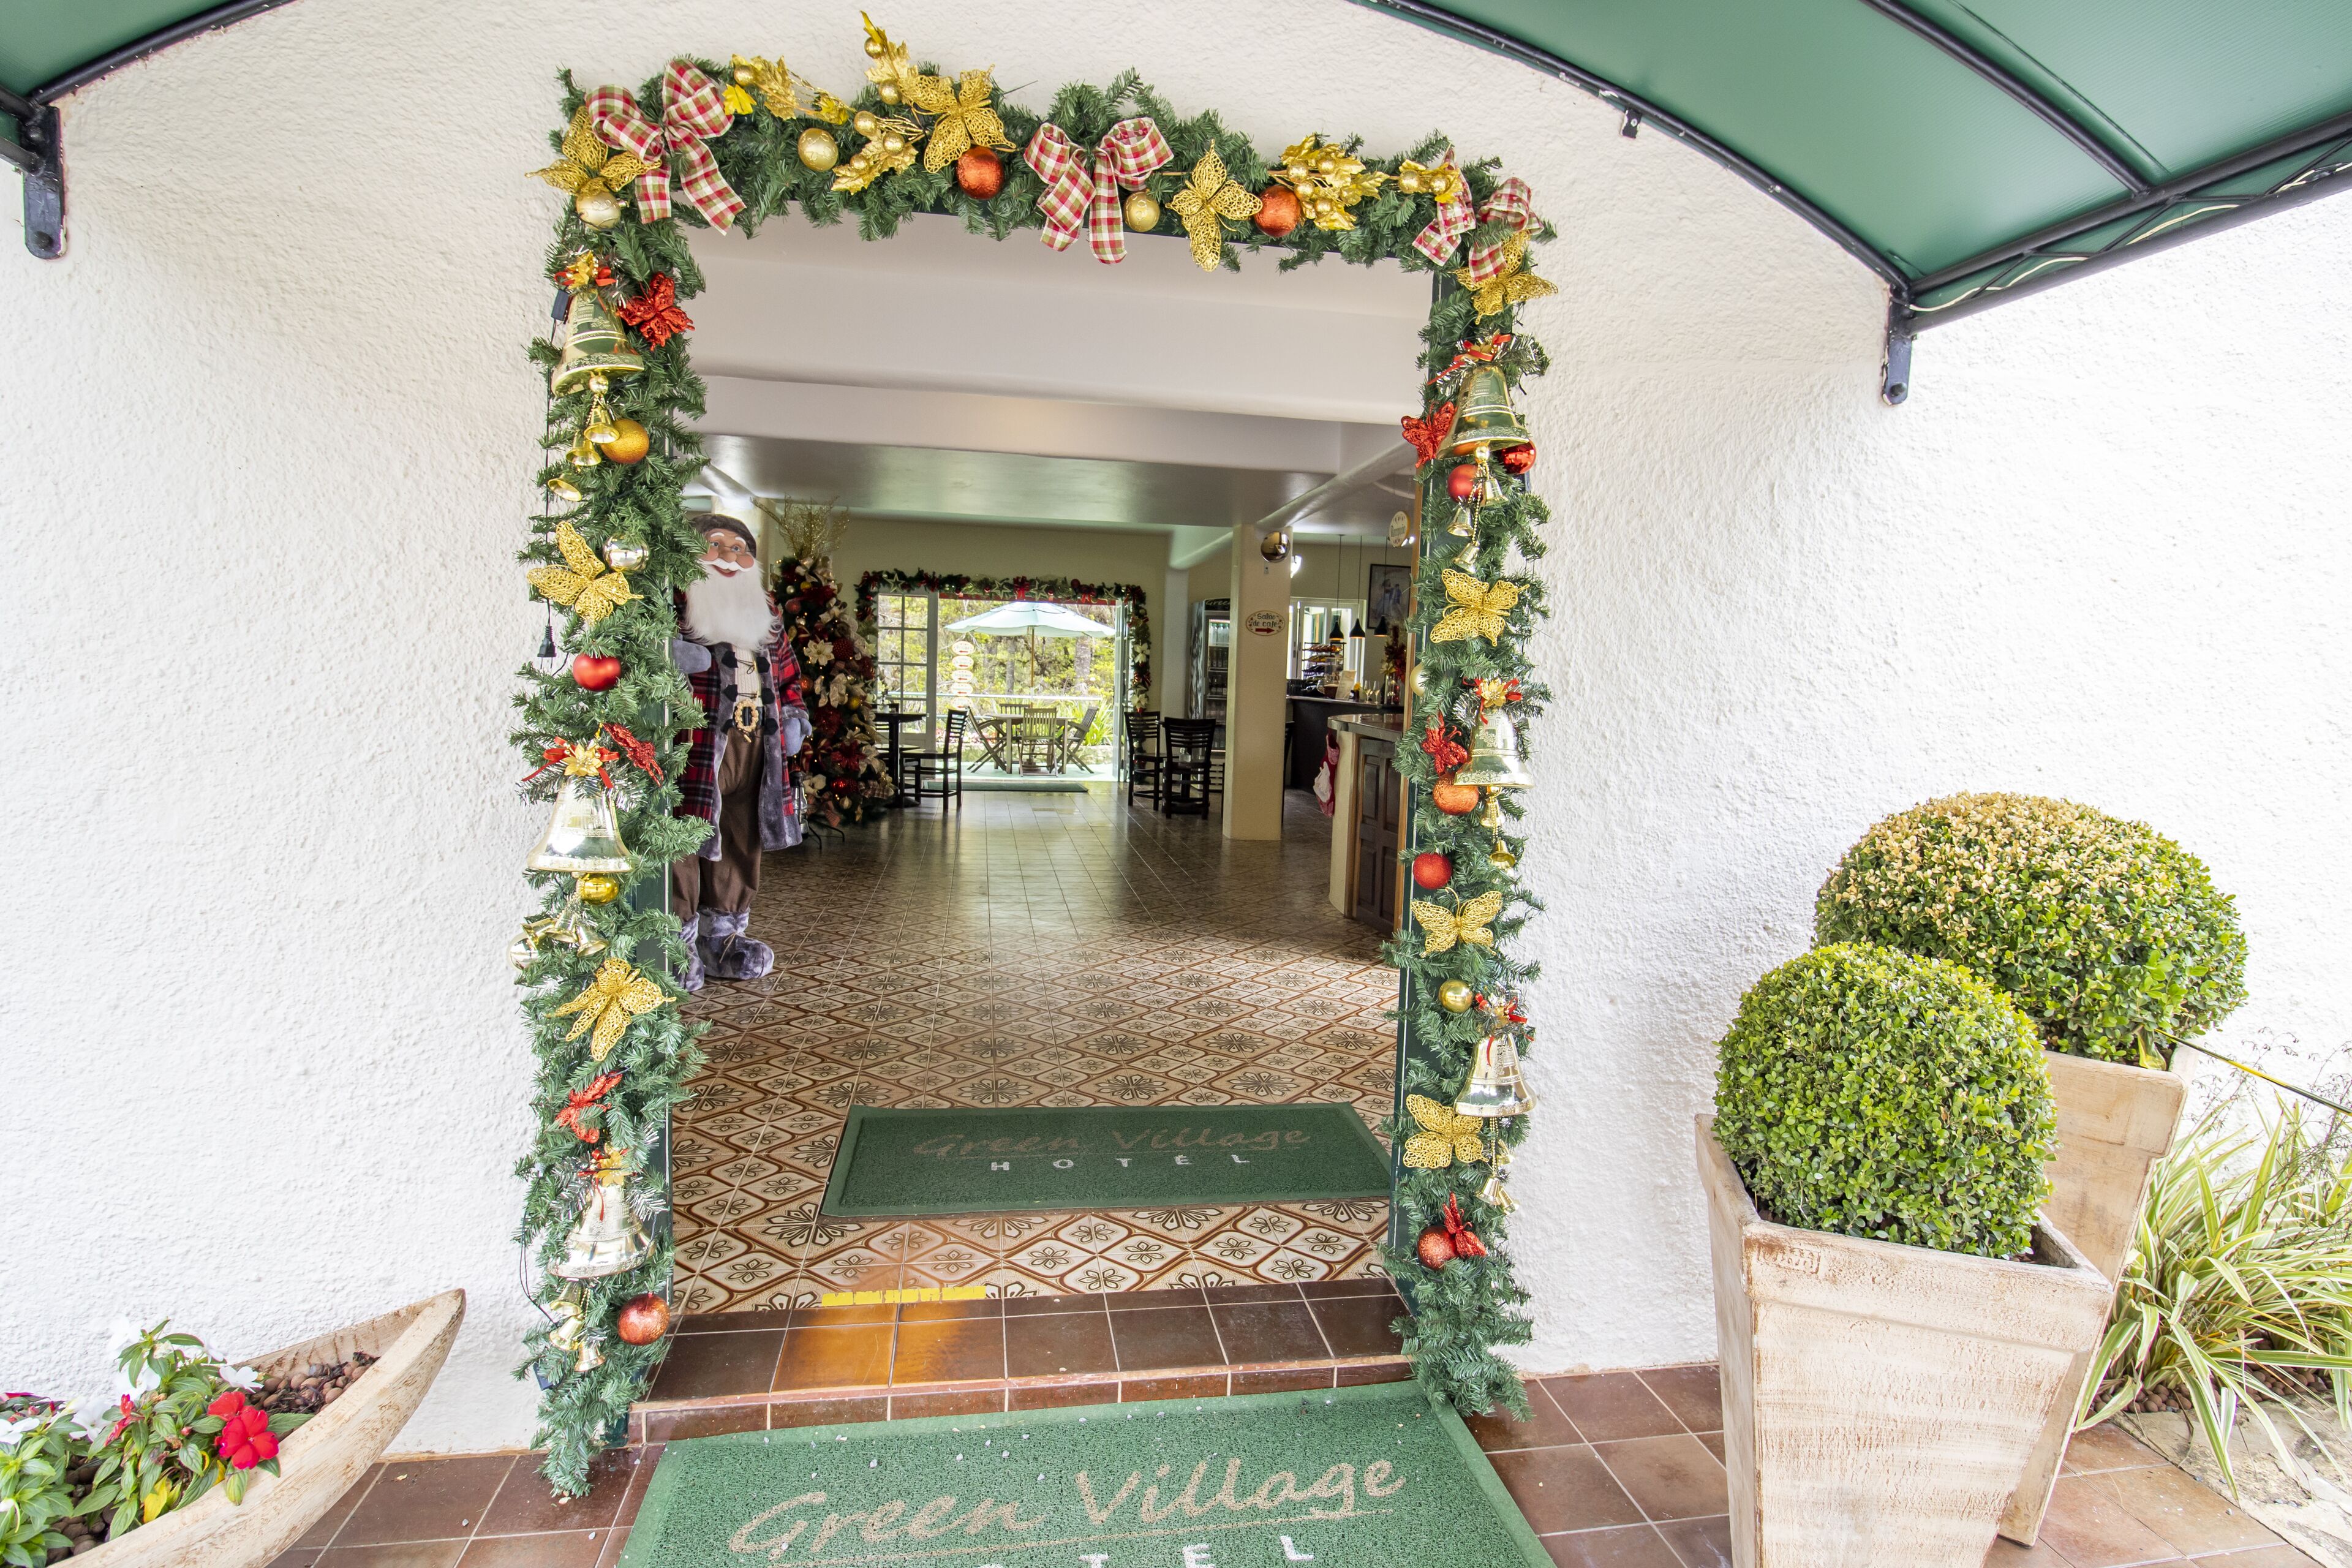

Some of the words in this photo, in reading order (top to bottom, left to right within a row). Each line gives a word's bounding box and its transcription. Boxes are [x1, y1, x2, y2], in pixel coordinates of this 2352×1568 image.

[913, 1134, 1079, 1158] Green
[1112, 1127, 1311, 1150] Village
[990, 1154, 1250, 1170] HOTEL
[728, 1491, 1046, 1561] Green
[1075, 1457, 1406, 1525] Village
